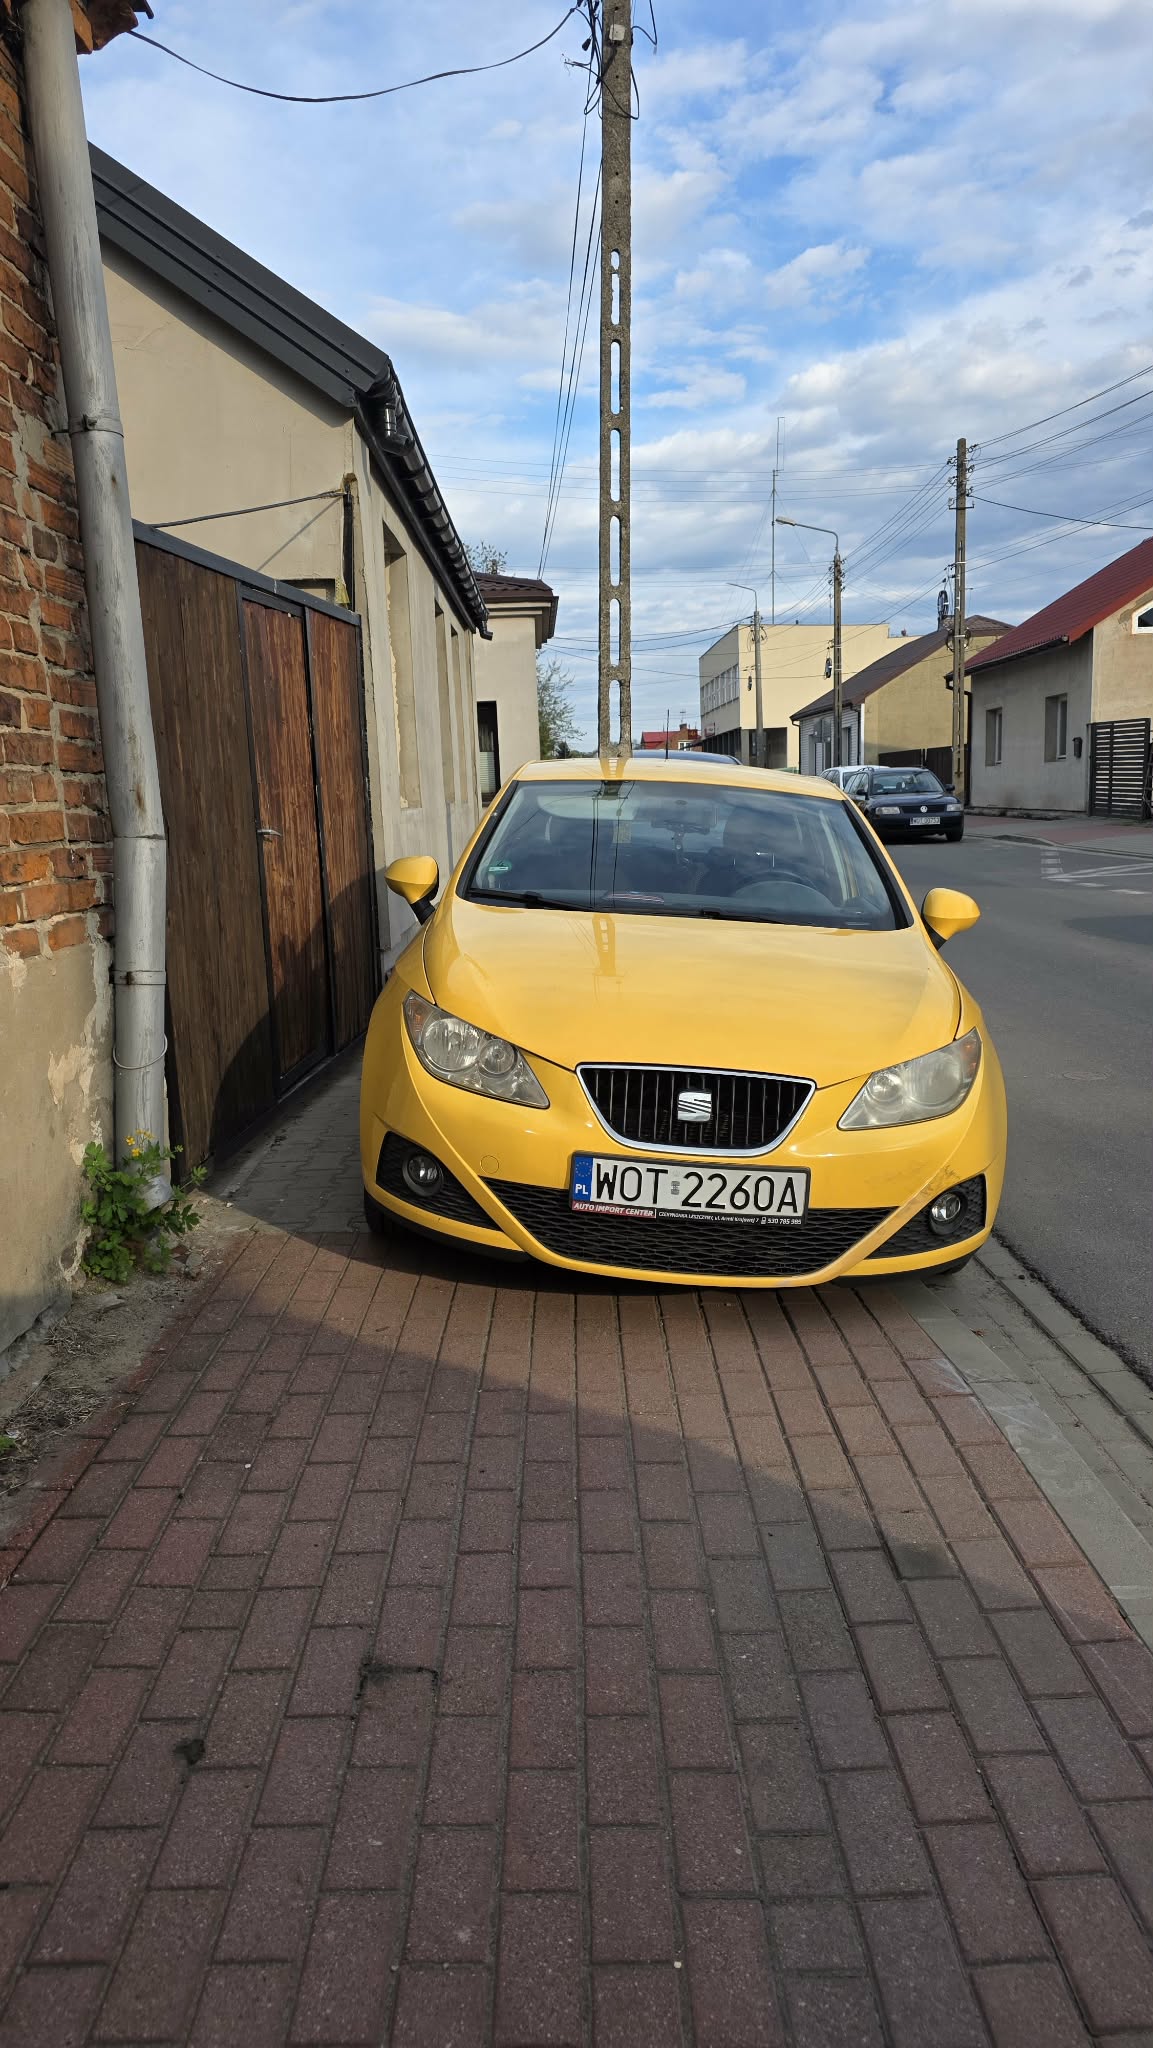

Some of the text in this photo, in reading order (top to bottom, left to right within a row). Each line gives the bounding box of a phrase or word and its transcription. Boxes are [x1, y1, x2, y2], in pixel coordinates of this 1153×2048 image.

[575, 1183, 589, 1195] PL
[596, 1163, 798, 1213] WOT 2260A
[574, 1202, 654, 1217] AUTO IMPORT CENTER
